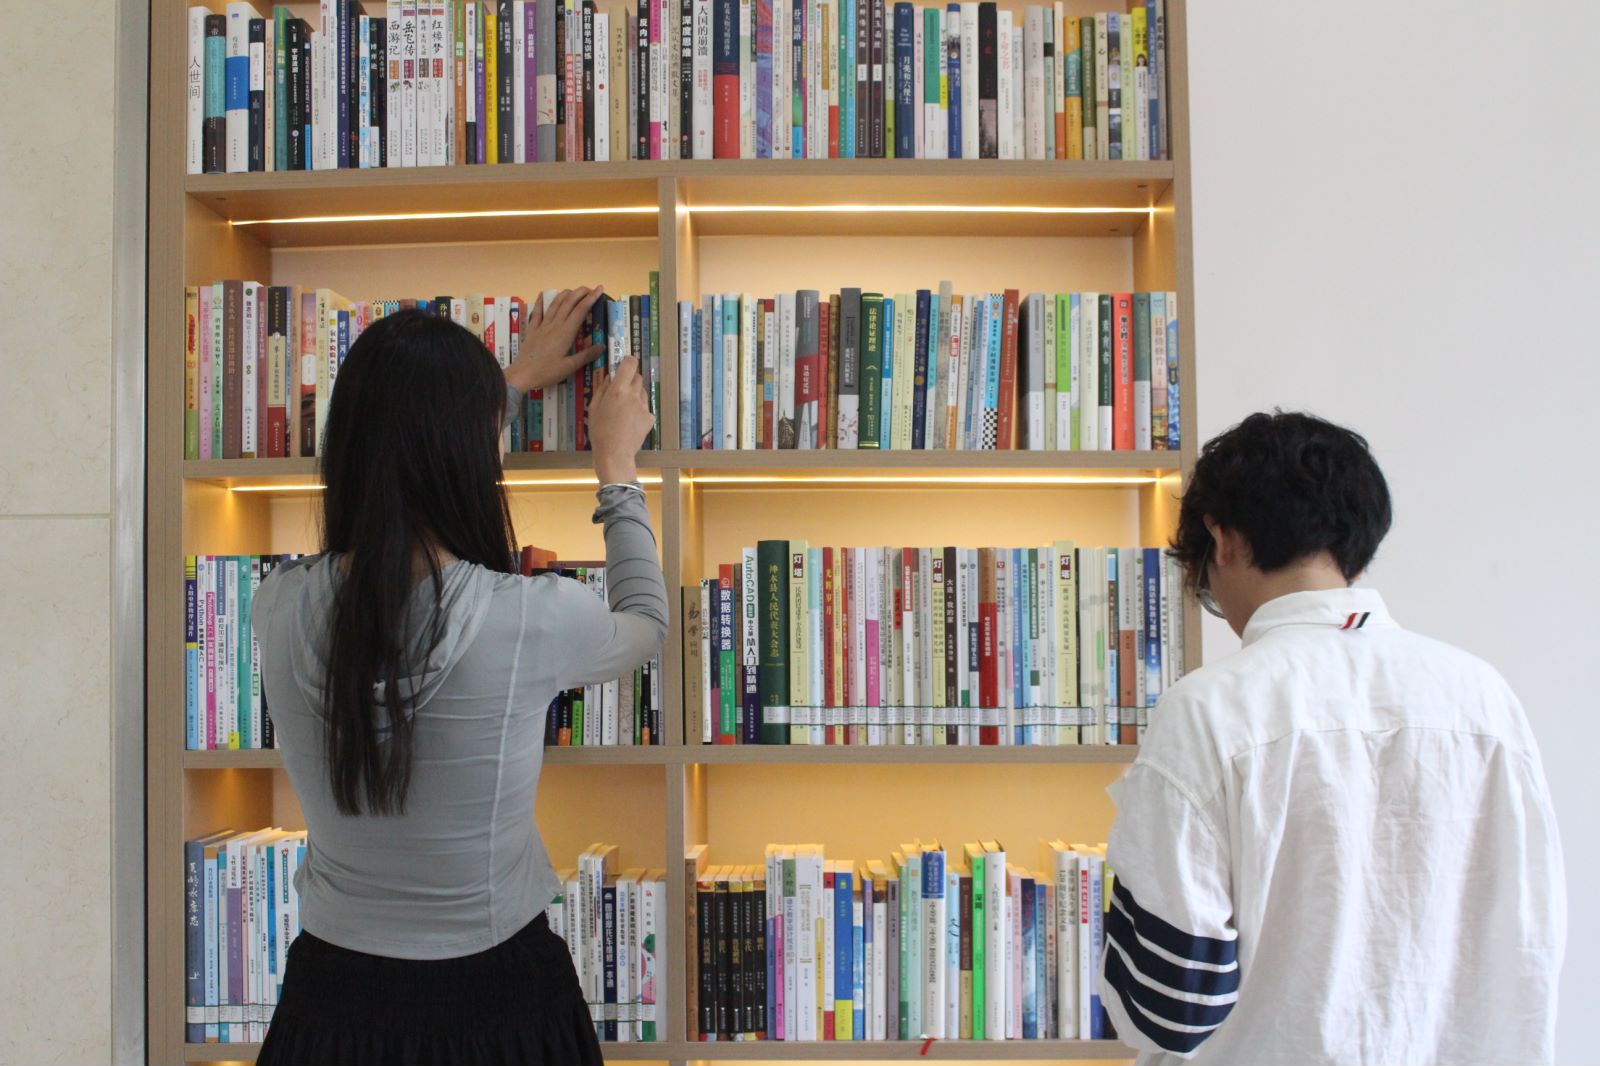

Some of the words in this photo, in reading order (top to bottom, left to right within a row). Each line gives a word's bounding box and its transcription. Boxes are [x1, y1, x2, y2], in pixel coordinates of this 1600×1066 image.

[388, 20, 401, 55] 西游记
[402, 21, 416, 56] 岳飞传
[432, 20, 444, 54] 红楼梦
[190, 56, 201, 99] 人世间
[903, 56, 912, 105] 月亮和六便士
[745, 555, 754, 603] AutoCAD
[793, 554, 803, 577] 灯塔
[933, 559, 943, 582] 灯塔
[720, 589, 732, 650] 数据转换器
